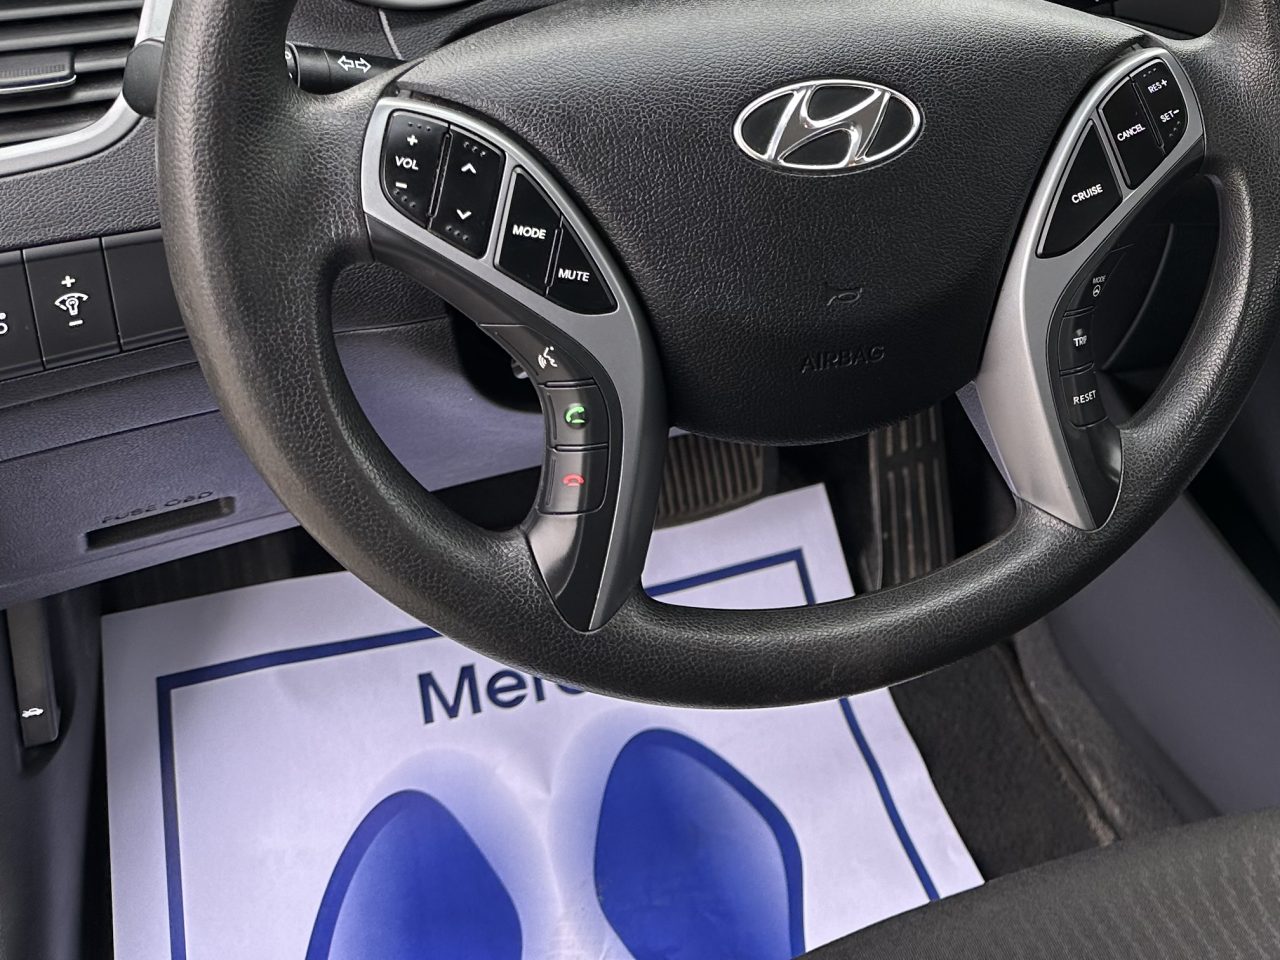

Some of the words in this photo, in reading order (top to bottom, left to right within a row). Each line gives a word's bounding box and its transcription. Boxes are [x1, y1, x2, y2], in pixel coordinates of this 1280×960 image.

[1117, 123, 1146, 142] CANCEL
[395, 155, 419, 171] VOL
[1071, 183, 1104, 204] CRUISE
[512, 224, 547, 240] MODE
[557, 268, 590, 282] MUTE
[801, 346, 886, 374] AIRBAG
[1073, 390, 1097, 406] RESET
